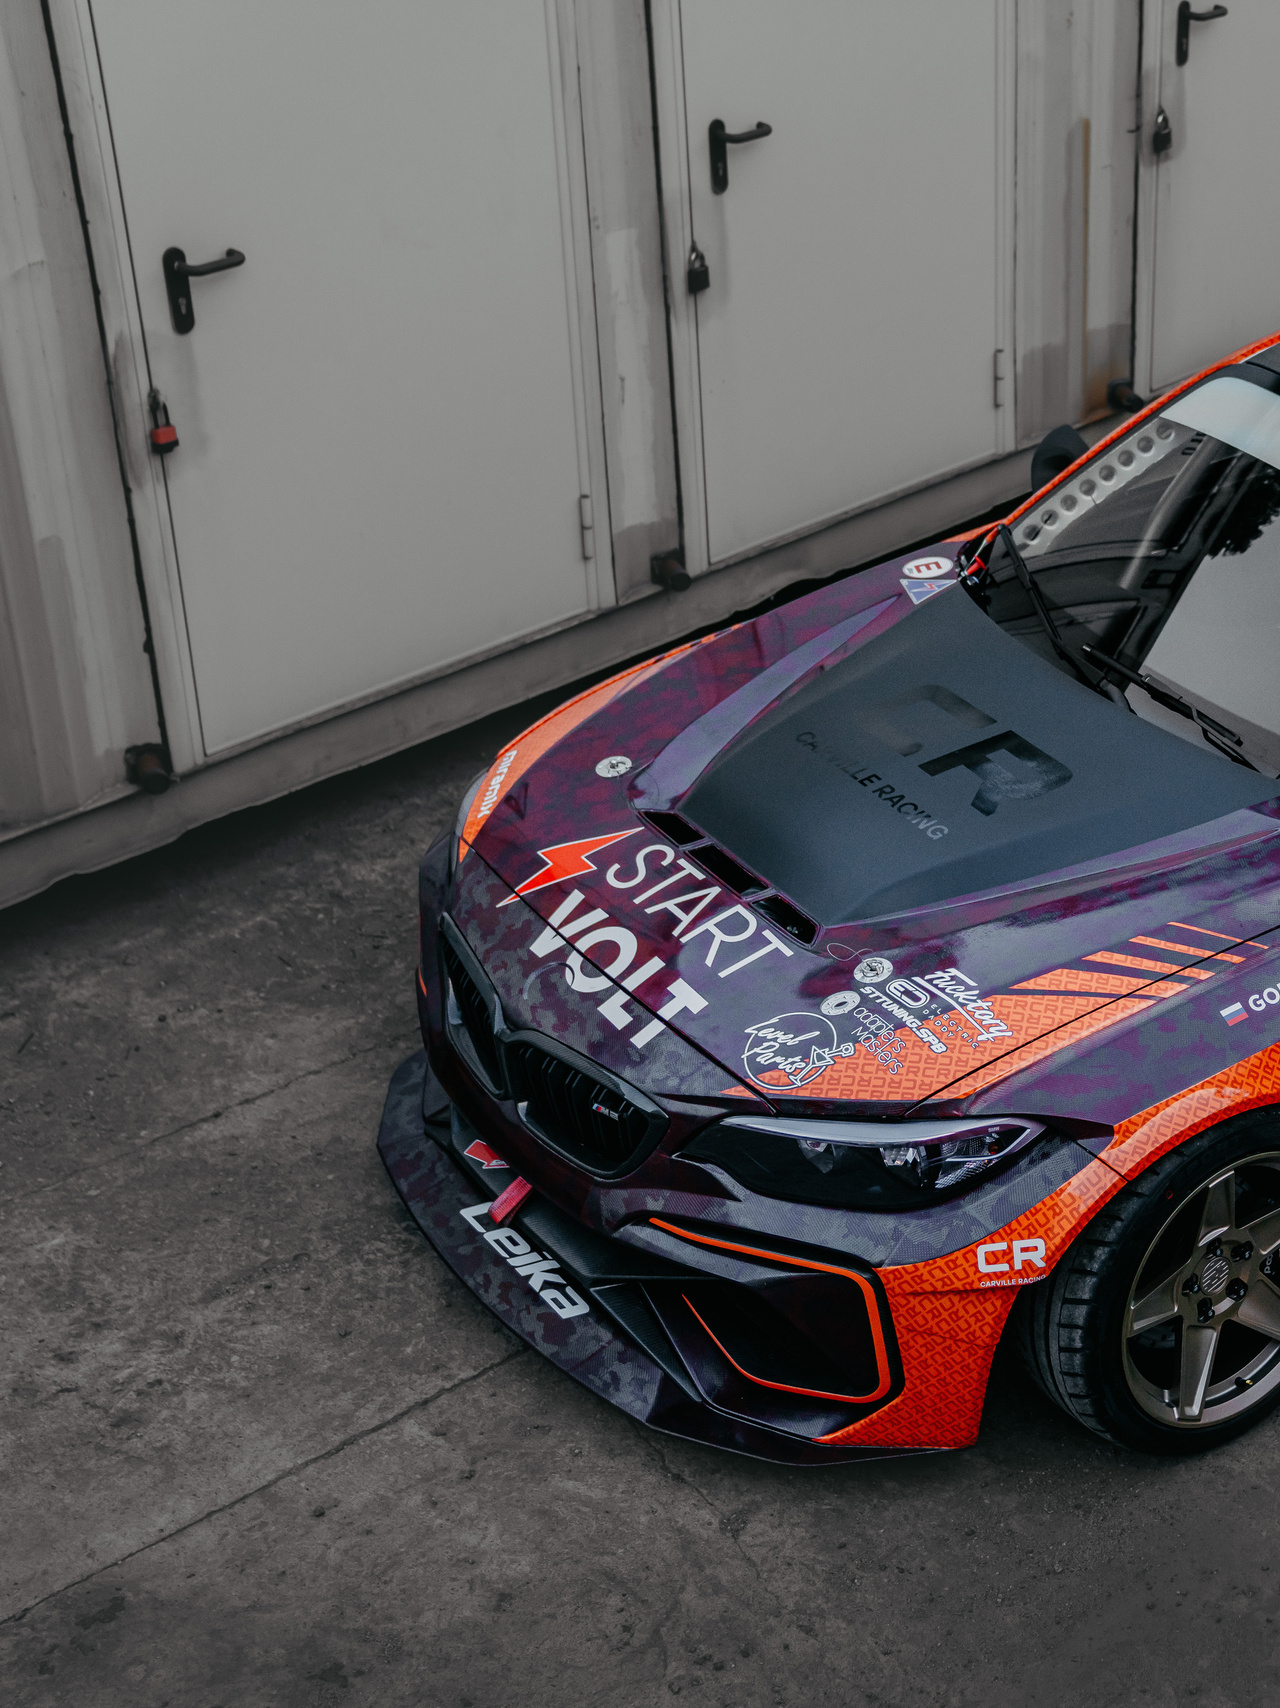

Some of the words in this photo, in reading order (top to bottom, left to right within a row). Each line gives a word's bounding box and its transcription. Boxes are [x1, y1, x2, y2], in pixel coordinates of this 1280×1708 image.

[913, 561, 943, 574] E
[477, 748, 517, 818] miramix
[606, 843, 795, 979] START
[528, 888, 709, 1050] VOLT
[916, 966, 1014, 1043] Fucktory
[922, 1008, 955, 1038] DADDY
[930, 1002, 980, 1050] ELECTRIC
[744, 1017, 821, 1047] Level
[850, 1025, 904, 1075] Masters
[853, 1006, 906, 1054] adapters
[741, 1041, 806, 1074] Parts
[459, 1201, 590, 1320] Leika
[976, 1237, 1047, 1273] CR
[979, 1278, 1016, 1288] CARVILLE
[1017, 1274, 1047, 1285] RACING
